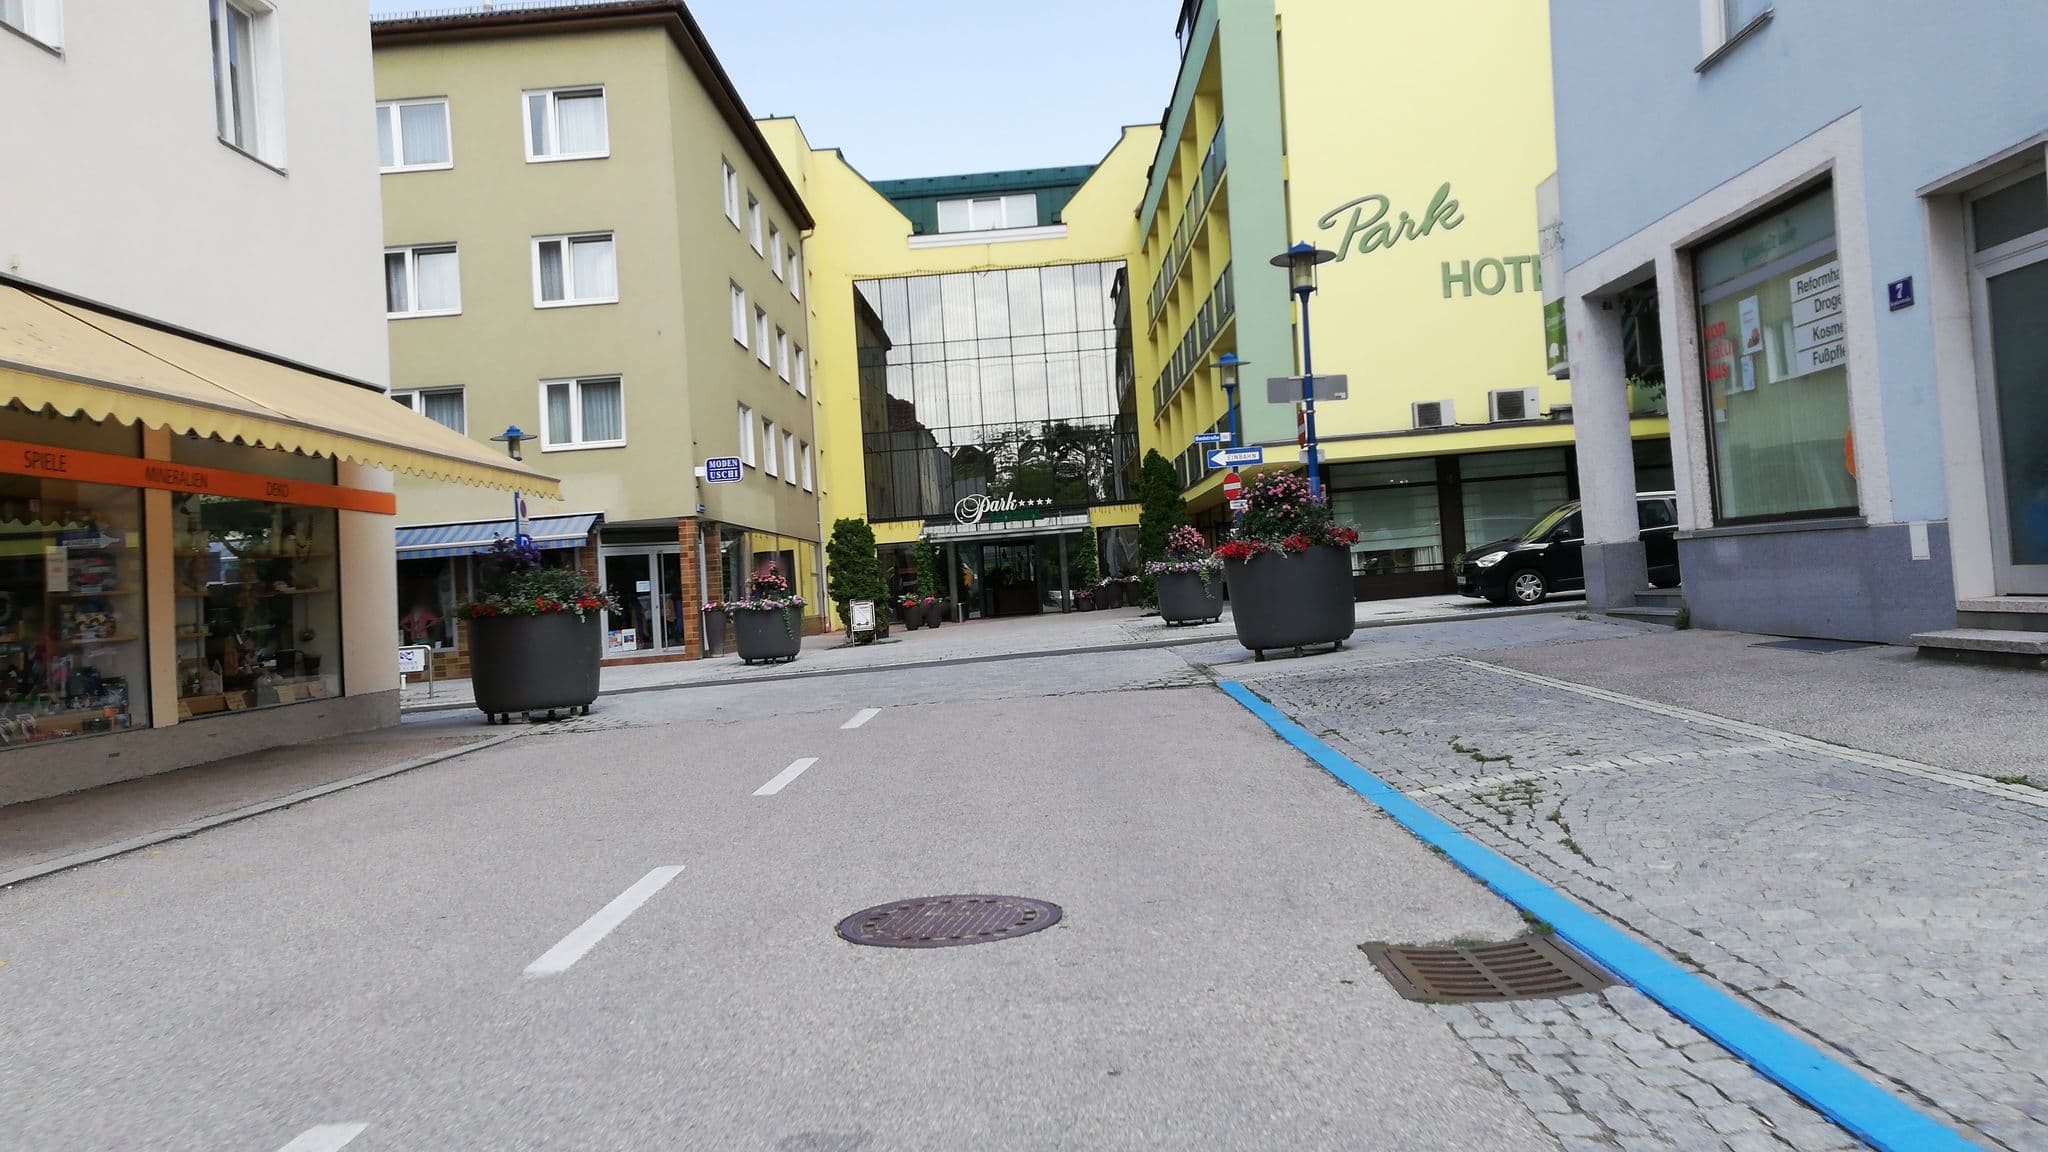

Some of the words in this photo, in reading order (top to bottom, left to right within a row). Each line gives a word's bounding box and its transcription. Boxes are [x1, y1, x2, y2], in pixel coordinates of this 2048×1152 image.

[1318, 182, 1465, 262] Park
[1895, 282, 1903, 299] 7
[24, 450, 67, 473] SPIELE
[145, 466, 208, 488] MINERALIEN
[265, 481, 289, 498] DEKO
[708, 459, 738, 468] MODEN
[710, 470, 738, 479] USCHI
[954, 491, 1018, 525] Park
